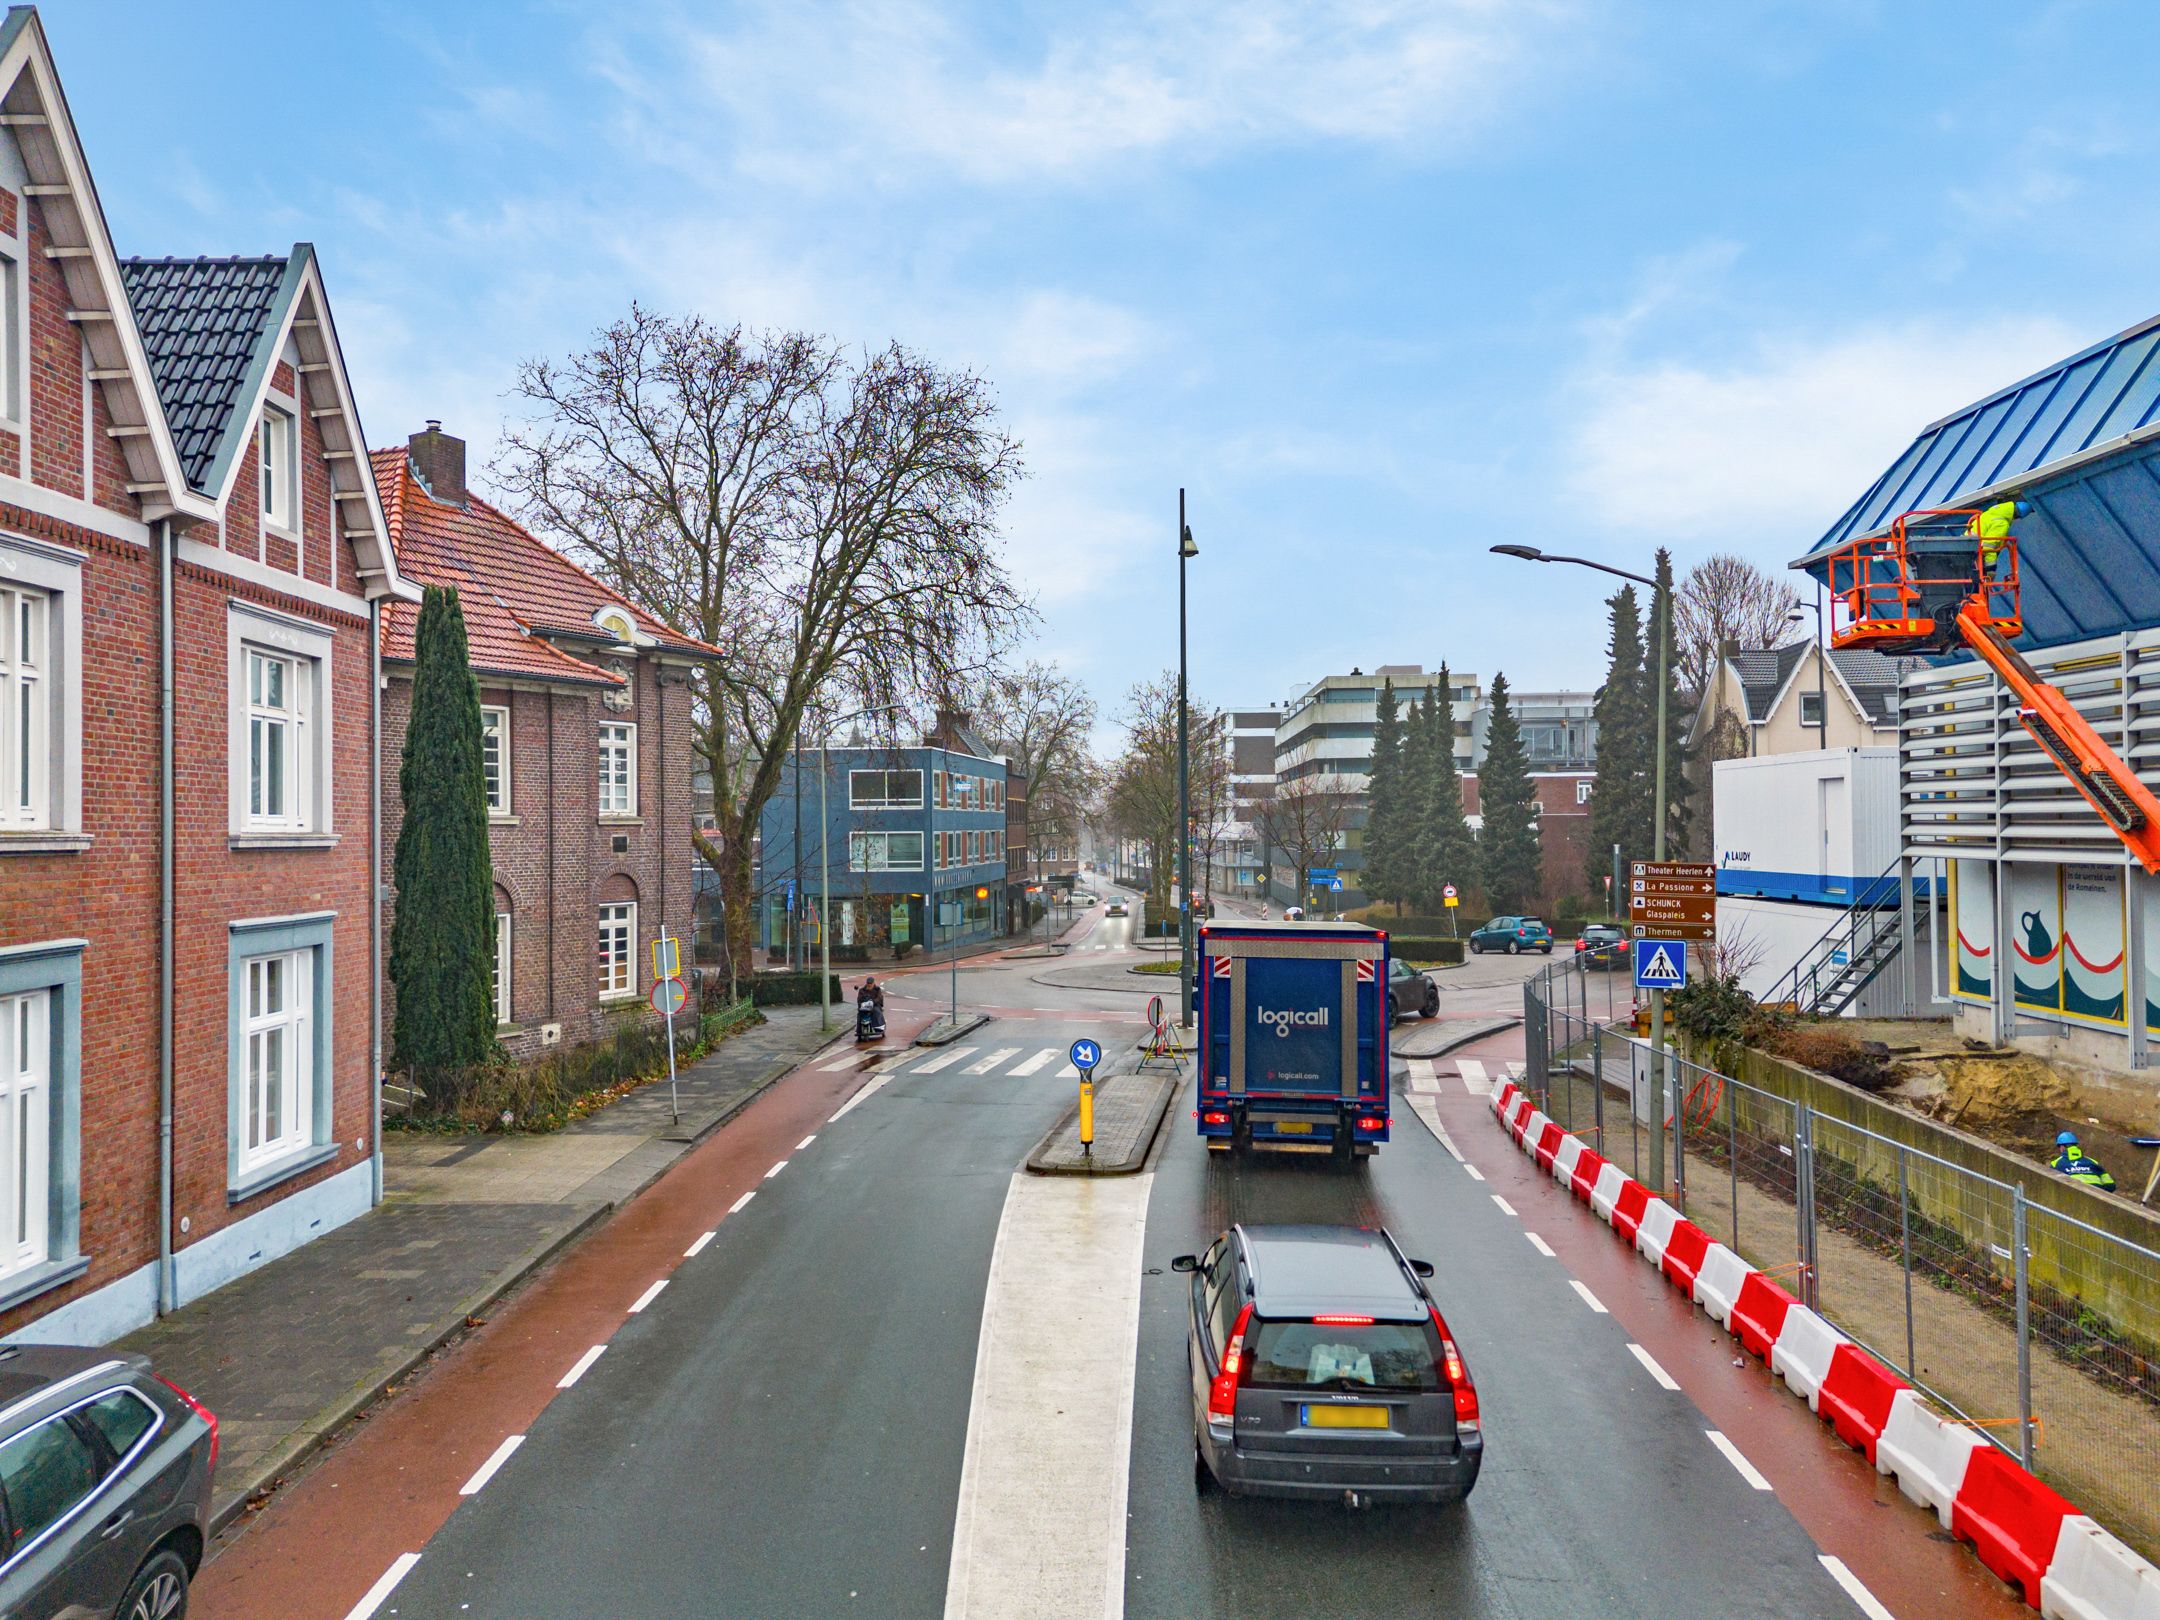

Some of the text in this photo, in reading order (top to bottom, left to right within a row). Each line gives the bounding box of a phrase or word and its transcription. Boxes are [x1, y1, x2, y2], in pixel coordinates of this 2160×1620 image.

[1731, 851, 1751, 861] LAUDY
[1648, 865, 1703, 875] Theater Heerlen
[1646, 882, 1694, 891] La Passione
[1647, 899, 1681, 908] SCHUNCK
[1646, 910, 1686, 919] Glaspaleis
[1648, 927, 1682, 936] Thermen
[1258, 1005, 1329, 1037] logicall
[1278, 1071, 1319, 1080] logicall.com
